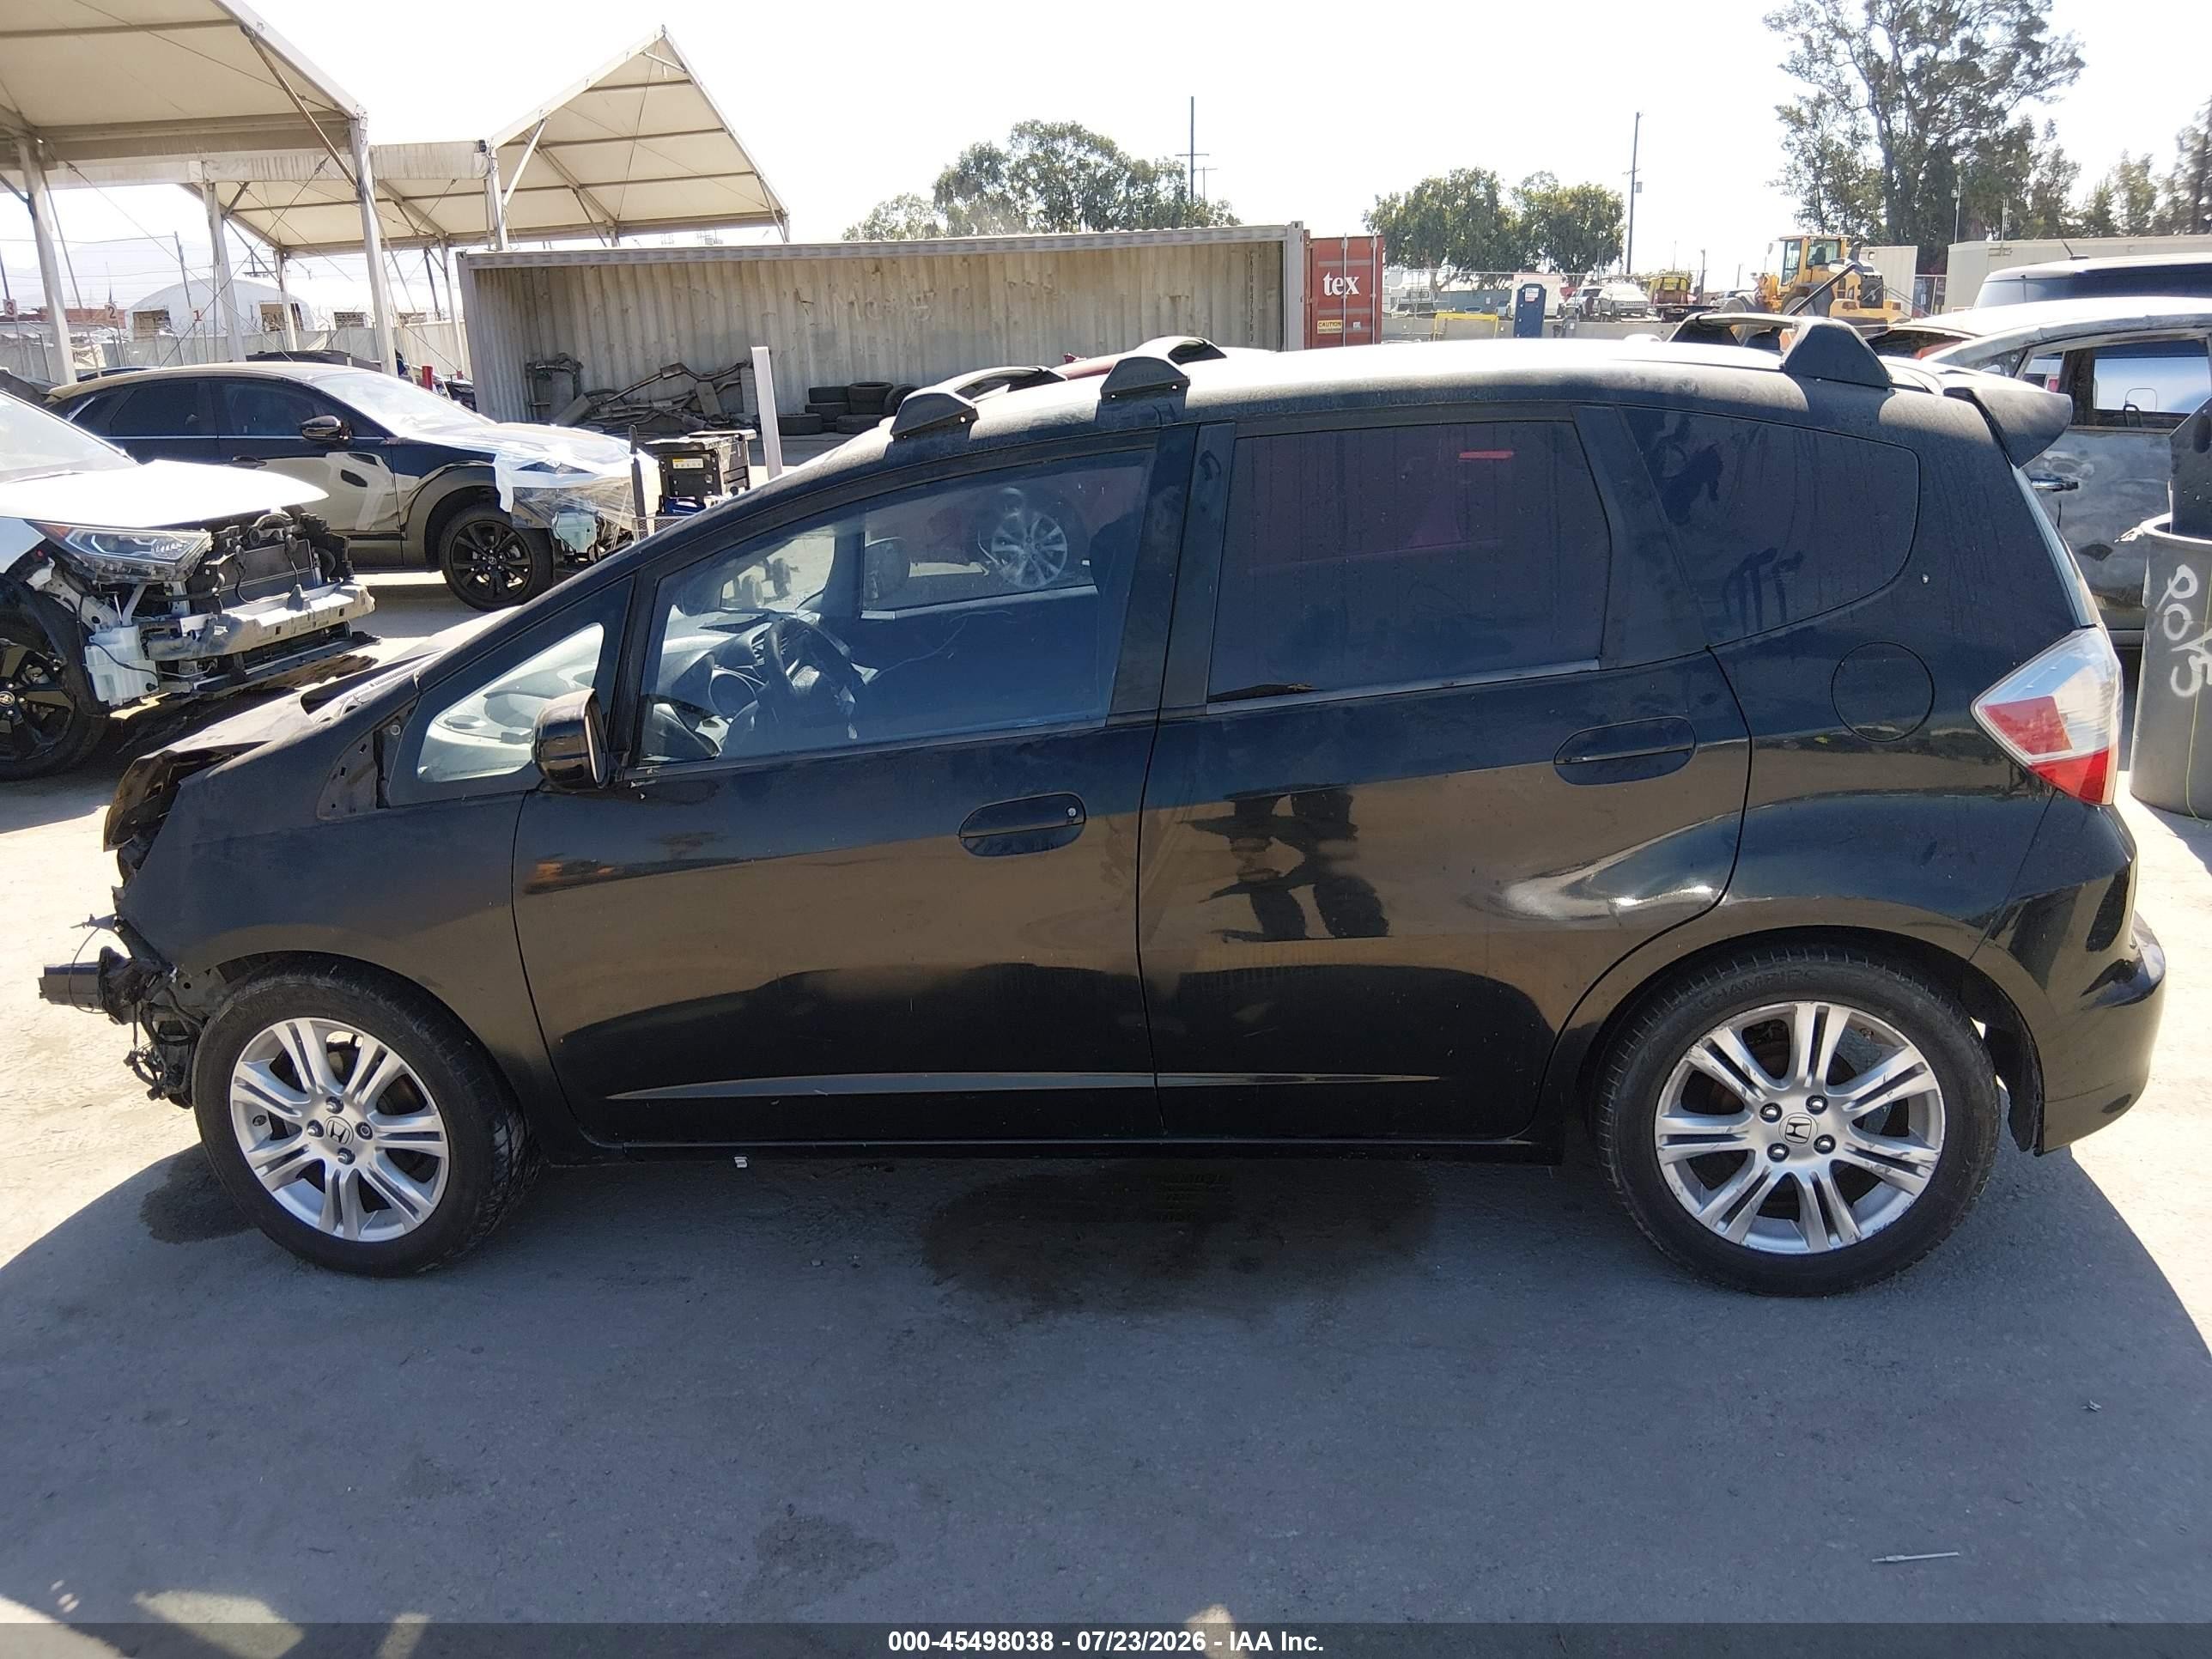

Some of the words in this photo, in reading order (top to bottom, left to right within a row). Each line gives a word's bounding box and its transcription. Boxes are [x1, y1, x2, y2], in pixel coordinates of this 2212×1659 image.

[1322, 271, 1360, 296] tex
[5, 302, 15, 316] 3
[107, 307, 117, 319] 2
[193, 309, 203, 322] 1
